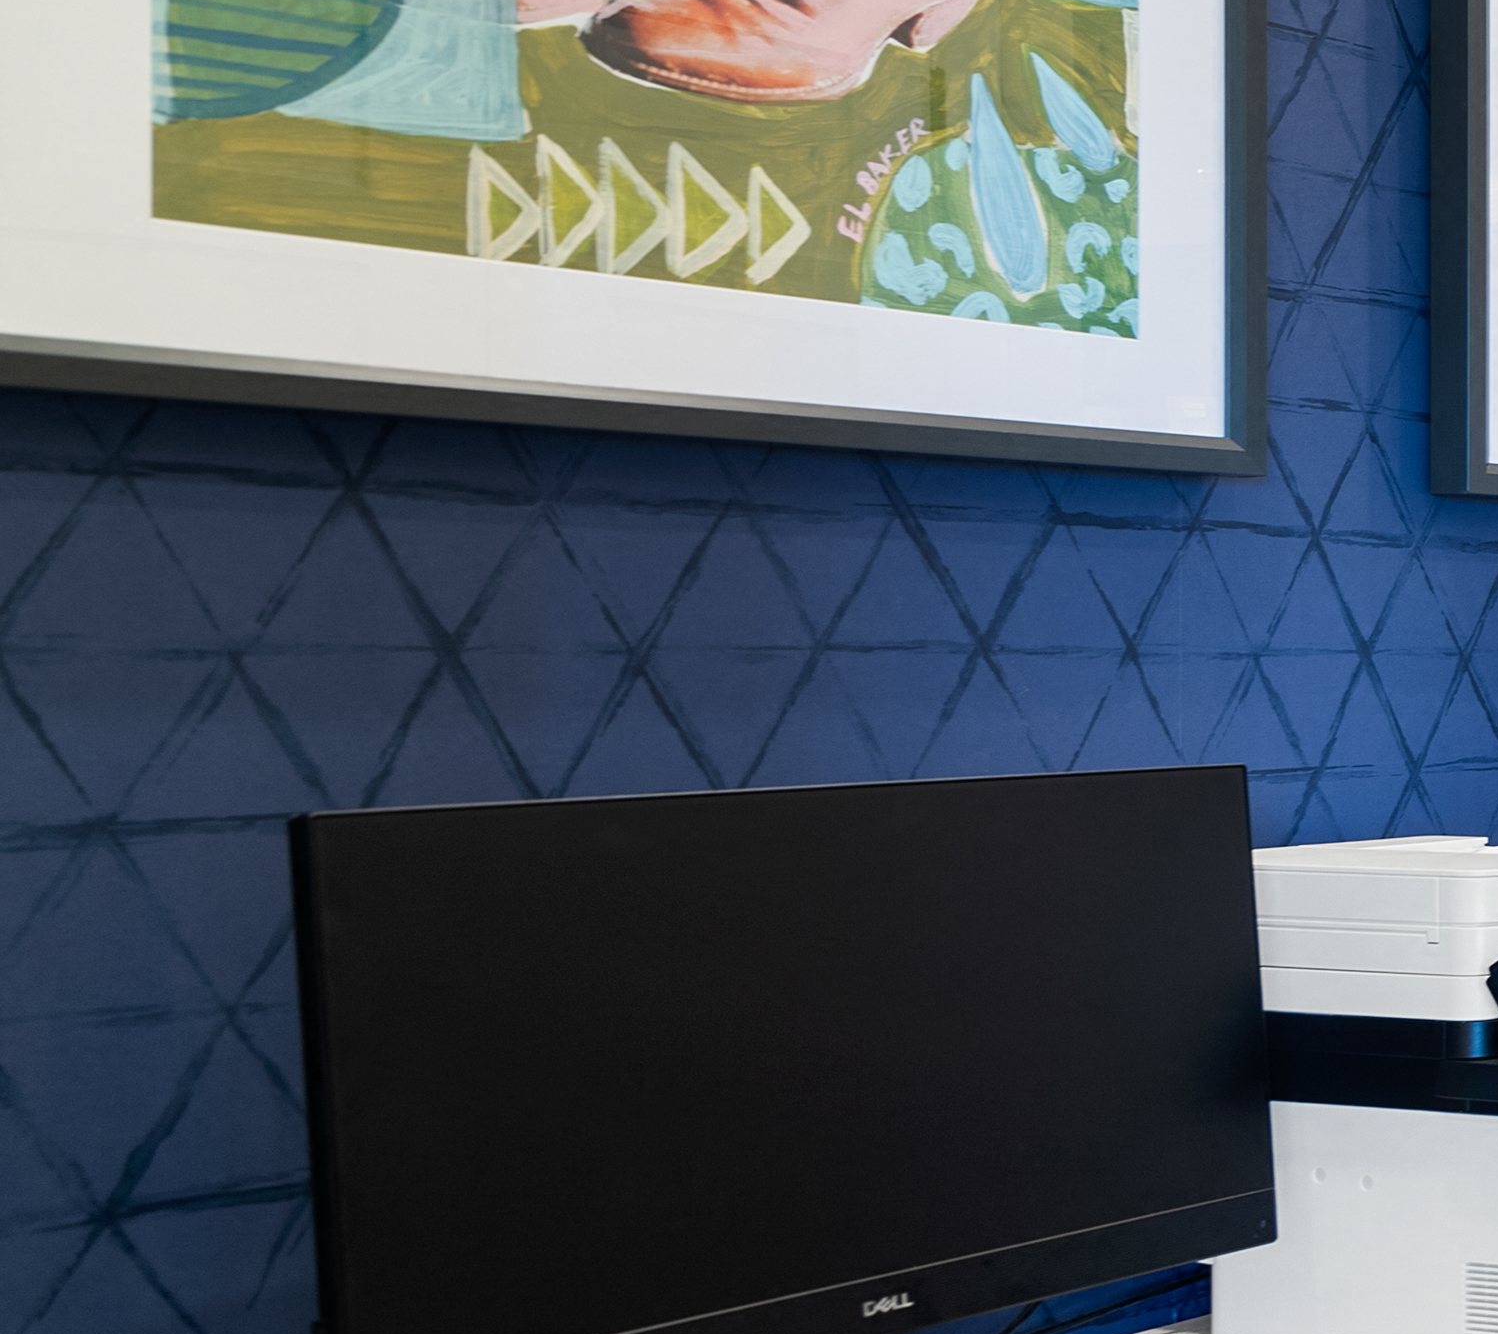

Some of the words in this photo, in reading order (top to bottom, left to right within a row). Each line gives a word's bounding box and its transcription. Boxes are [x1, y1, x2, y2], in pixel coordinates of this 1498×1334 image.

[837, 202, 872, 243] EL
[855, 117, 933, 195] BAKER
[862, 1291, 915, 1317] DELL
